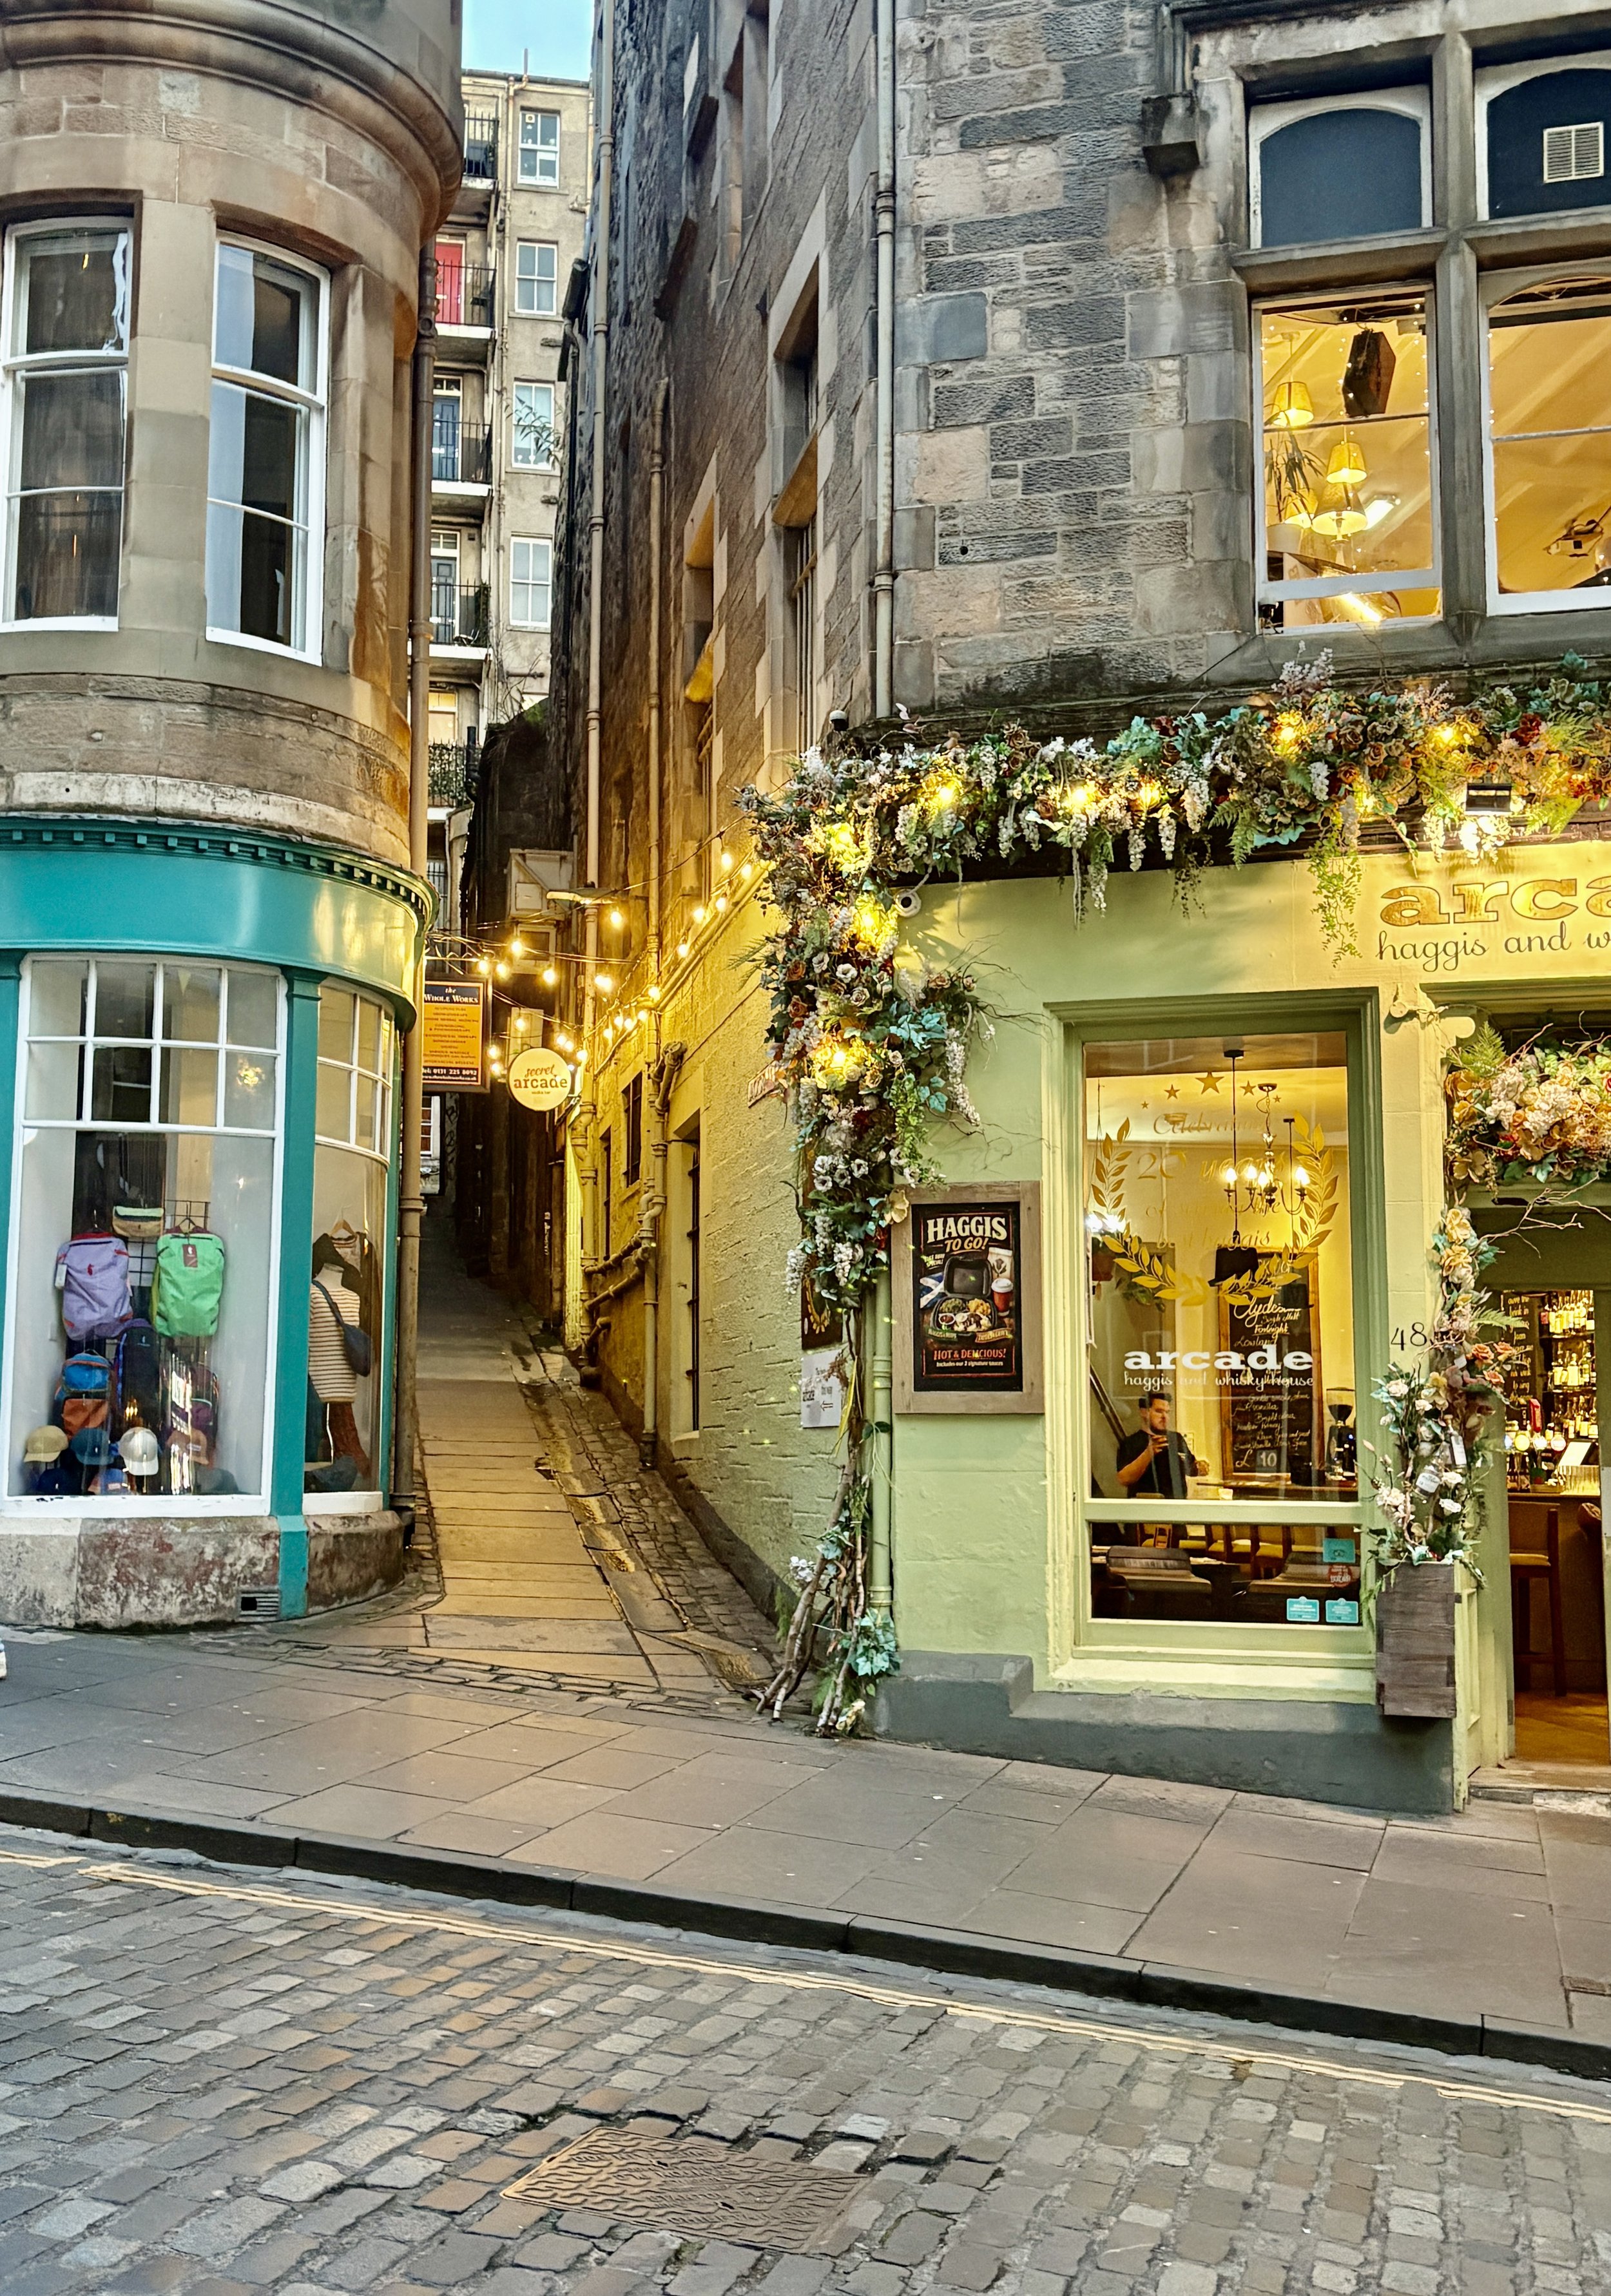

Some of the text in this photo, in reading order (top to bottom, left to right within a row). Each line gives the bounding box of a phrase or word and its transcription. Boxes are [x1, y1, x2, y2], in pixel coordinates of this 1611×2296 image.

[1376, 930, 1489, 972] haggis
[1504, 921, 1572, 953] and
[525, 1064, 555, 1078] secret
[514, 1075, 568, 1089] arcade
[927, 1216, 1007, 1243] HAGGIS
[945, 1237, 989, 1252] TO GO!
[1391, 1322, 1427, 1351] 48
[934, 1350, 952, 1361] HOT
[961, 1348, 1007, 1359] DELICIOUS!
[1124, 1344, 1313, 1370] arcade
[1124, 1372, 1173, 1391] haggis
[1215, 1372, 1264, 1392] whisky
[1271, 1372, 1313, 1386] house
[1260, 1451, 1277, 1467] 10
